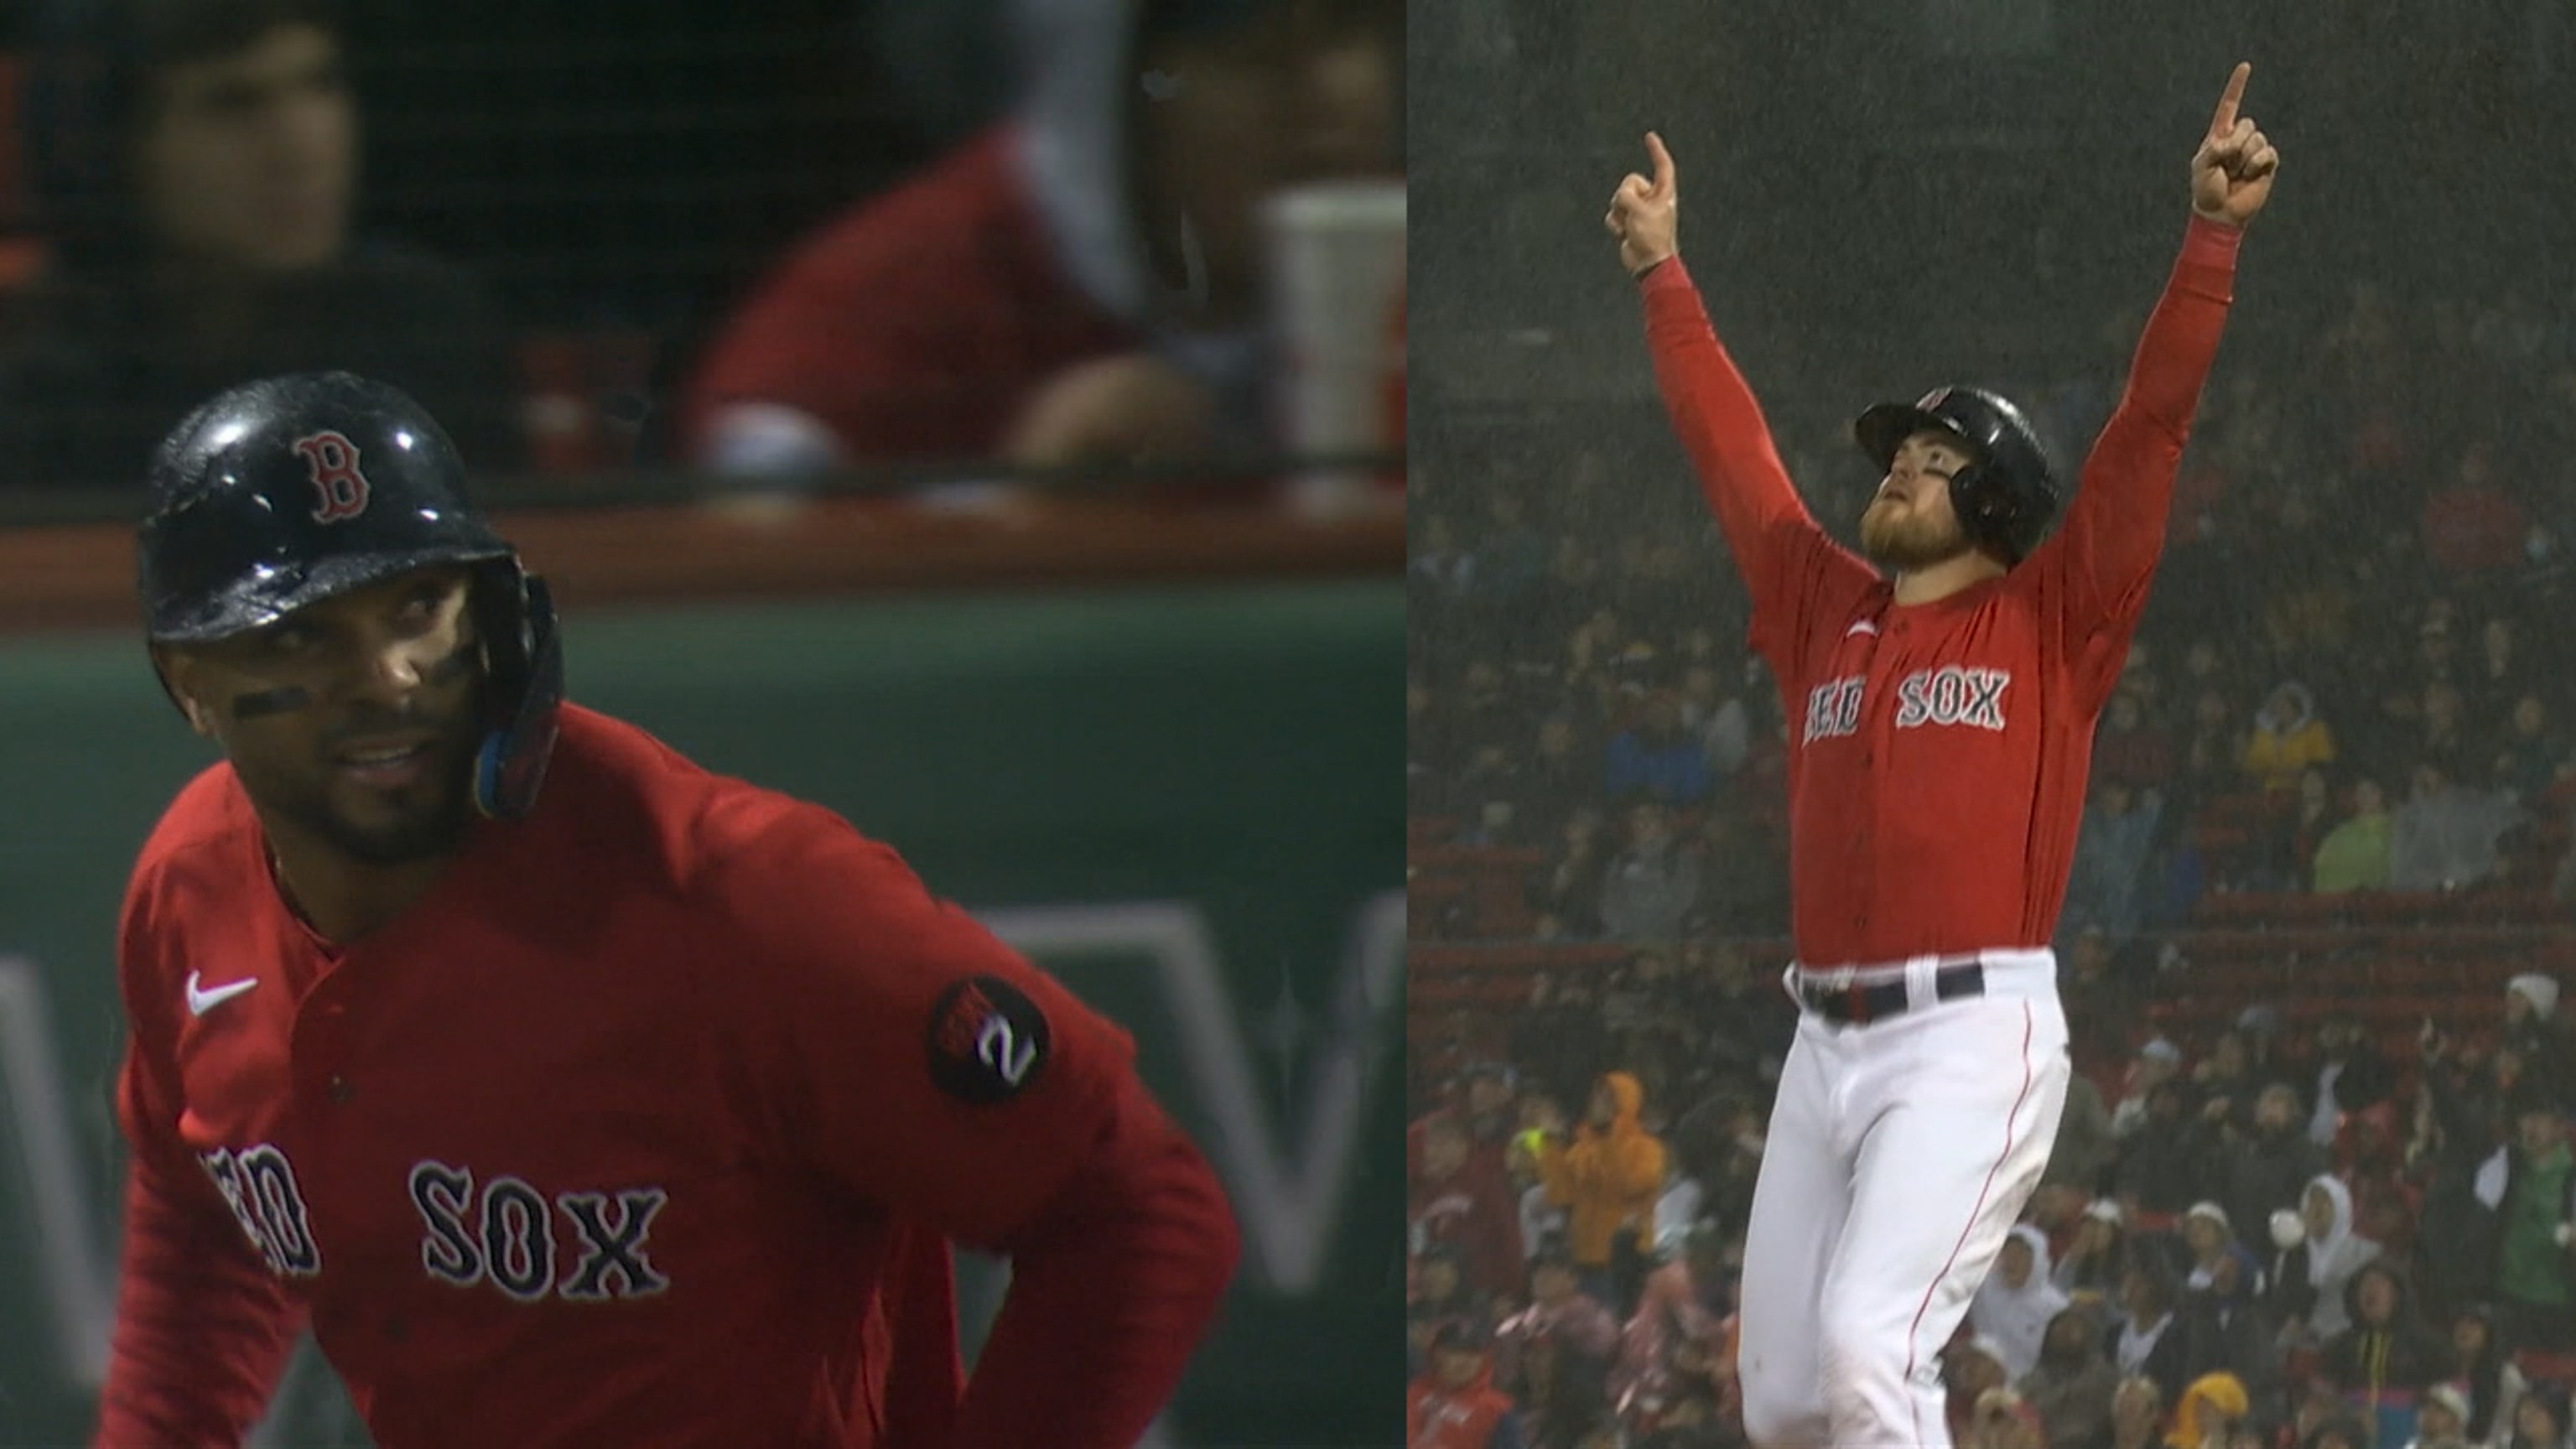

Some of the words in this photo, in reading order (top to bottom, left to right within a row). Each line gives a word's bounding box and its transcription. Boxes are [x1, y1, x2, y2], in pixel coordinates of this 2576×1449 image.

[292, 430, 371, 525] B
[1896, 665, 2010, 730] SOX
[976, 1013, 1037, 1088] 2
[197, 1143, 321, 1276] ED
[409, 1161, 669, 1301] SOX
